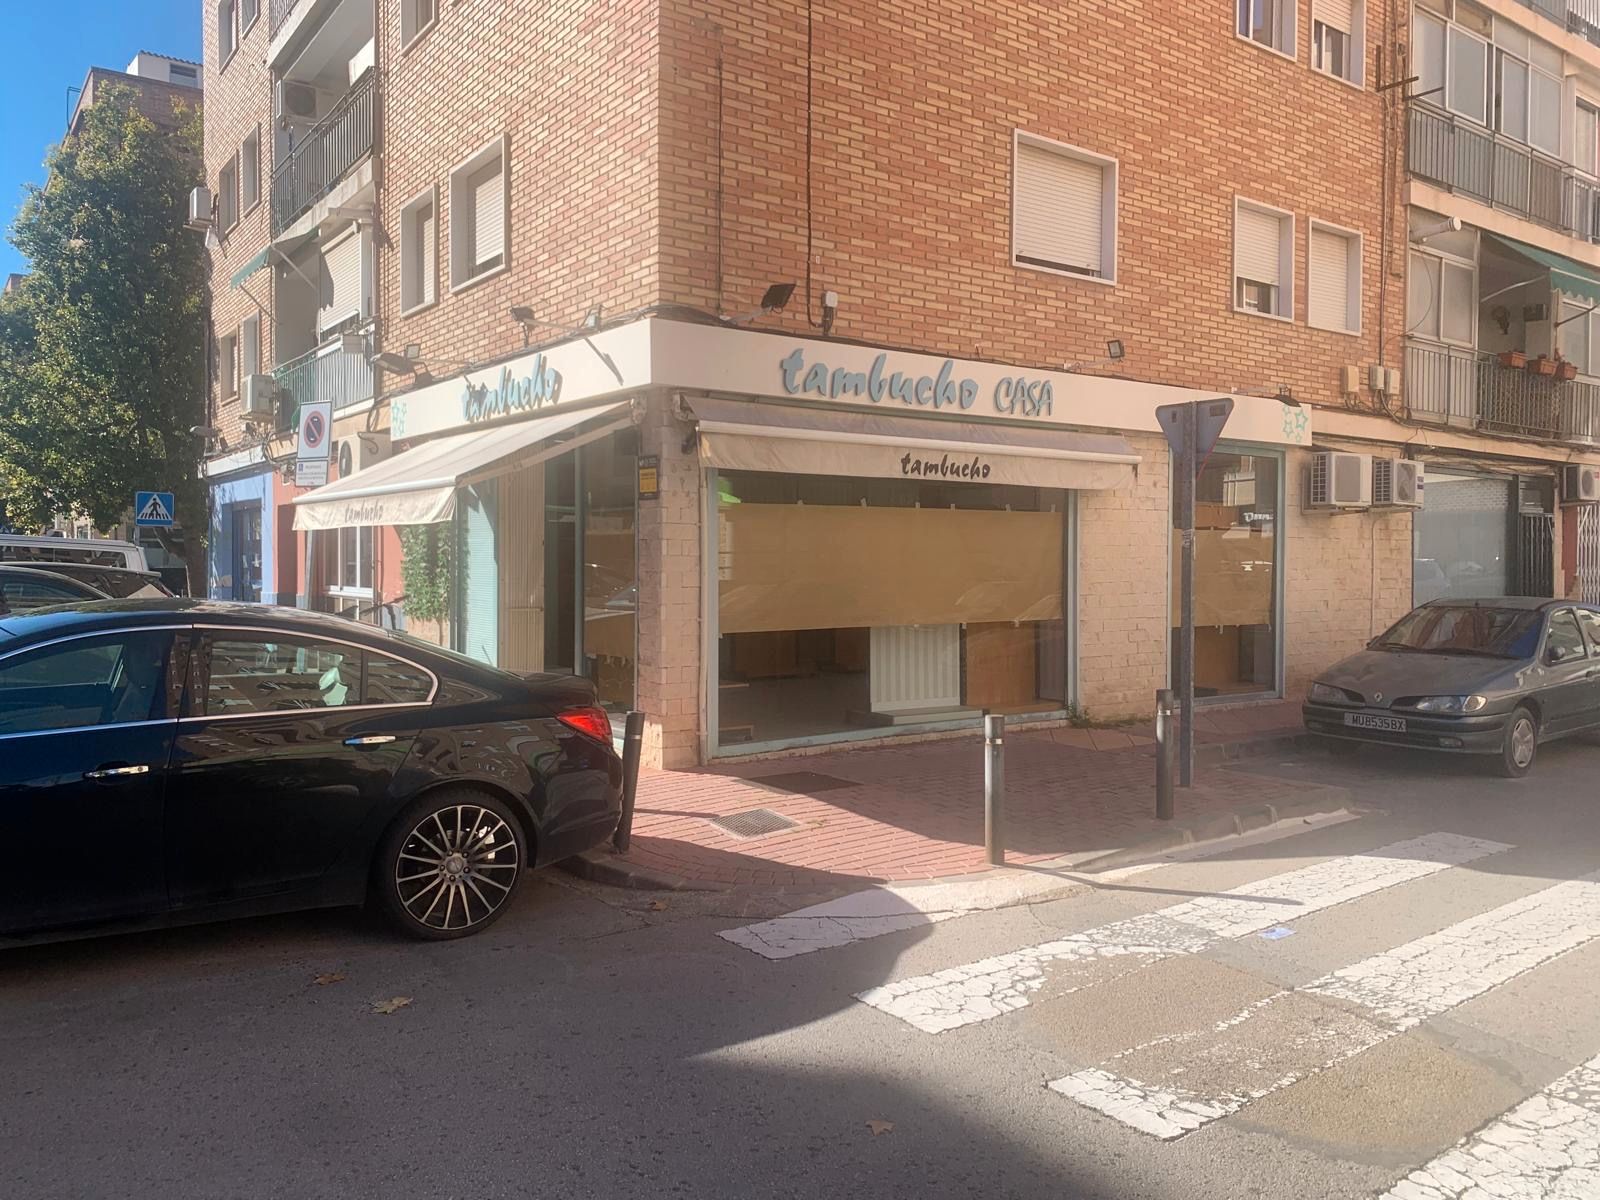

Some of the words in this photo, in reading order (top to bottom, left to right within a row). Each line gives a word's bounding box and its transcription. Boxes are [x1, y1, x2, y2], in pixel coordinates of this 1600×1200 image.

[461, 352, 558, 422] tambucho
[780, 348, 979, 410] tambucho
[993, 376, 1054, 416] CASA
[901, 452, 991, 479] tambucho
[344, 498, 384, 524] tambucho
